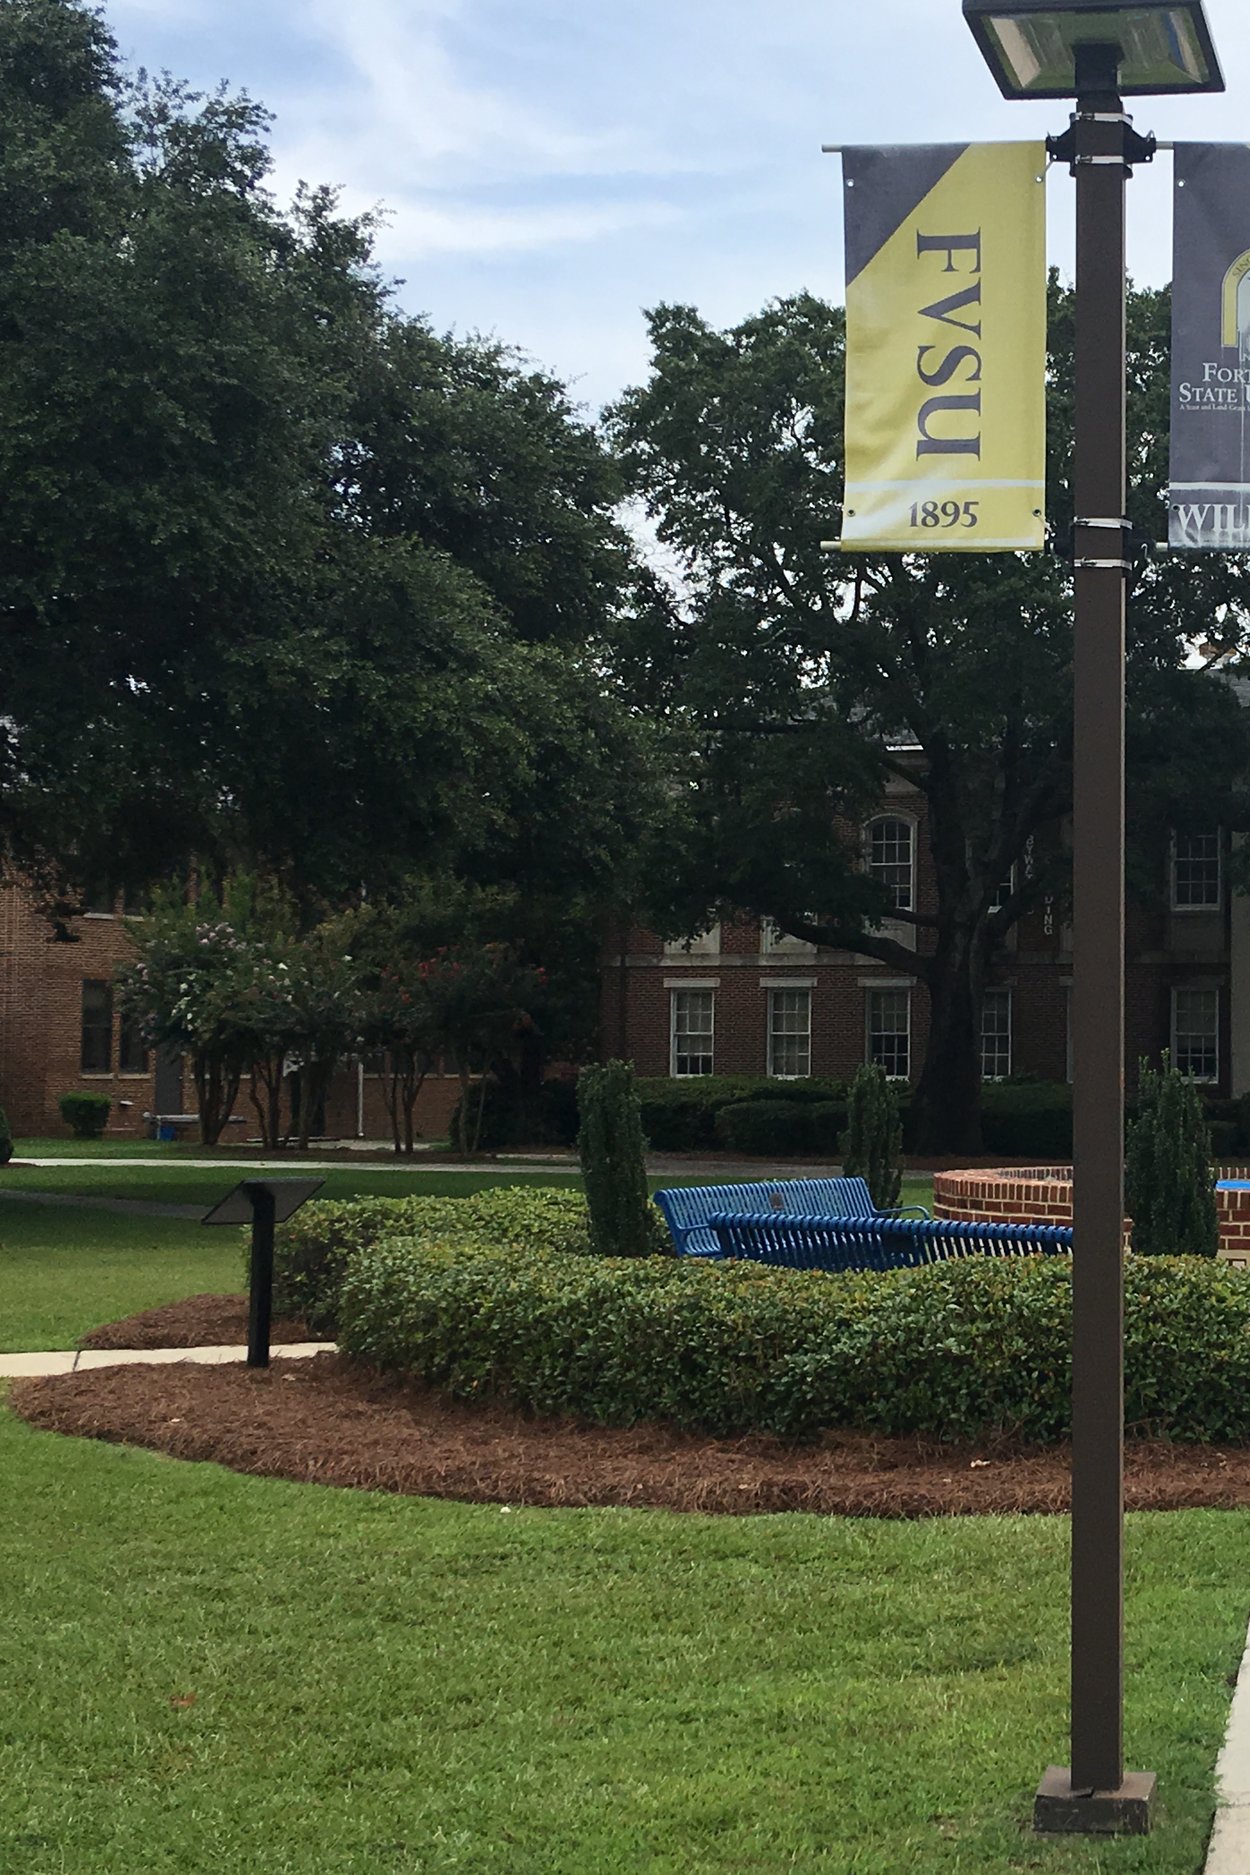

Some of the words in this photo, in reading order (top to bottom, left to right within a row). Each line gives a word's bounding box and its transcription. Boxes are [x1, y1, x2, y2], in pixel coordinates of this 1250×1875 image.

[915, 226, 983, 463] FVSU
[1178, 382, 1238, 403] STATE
[907, 500, 980, 528] 1895
